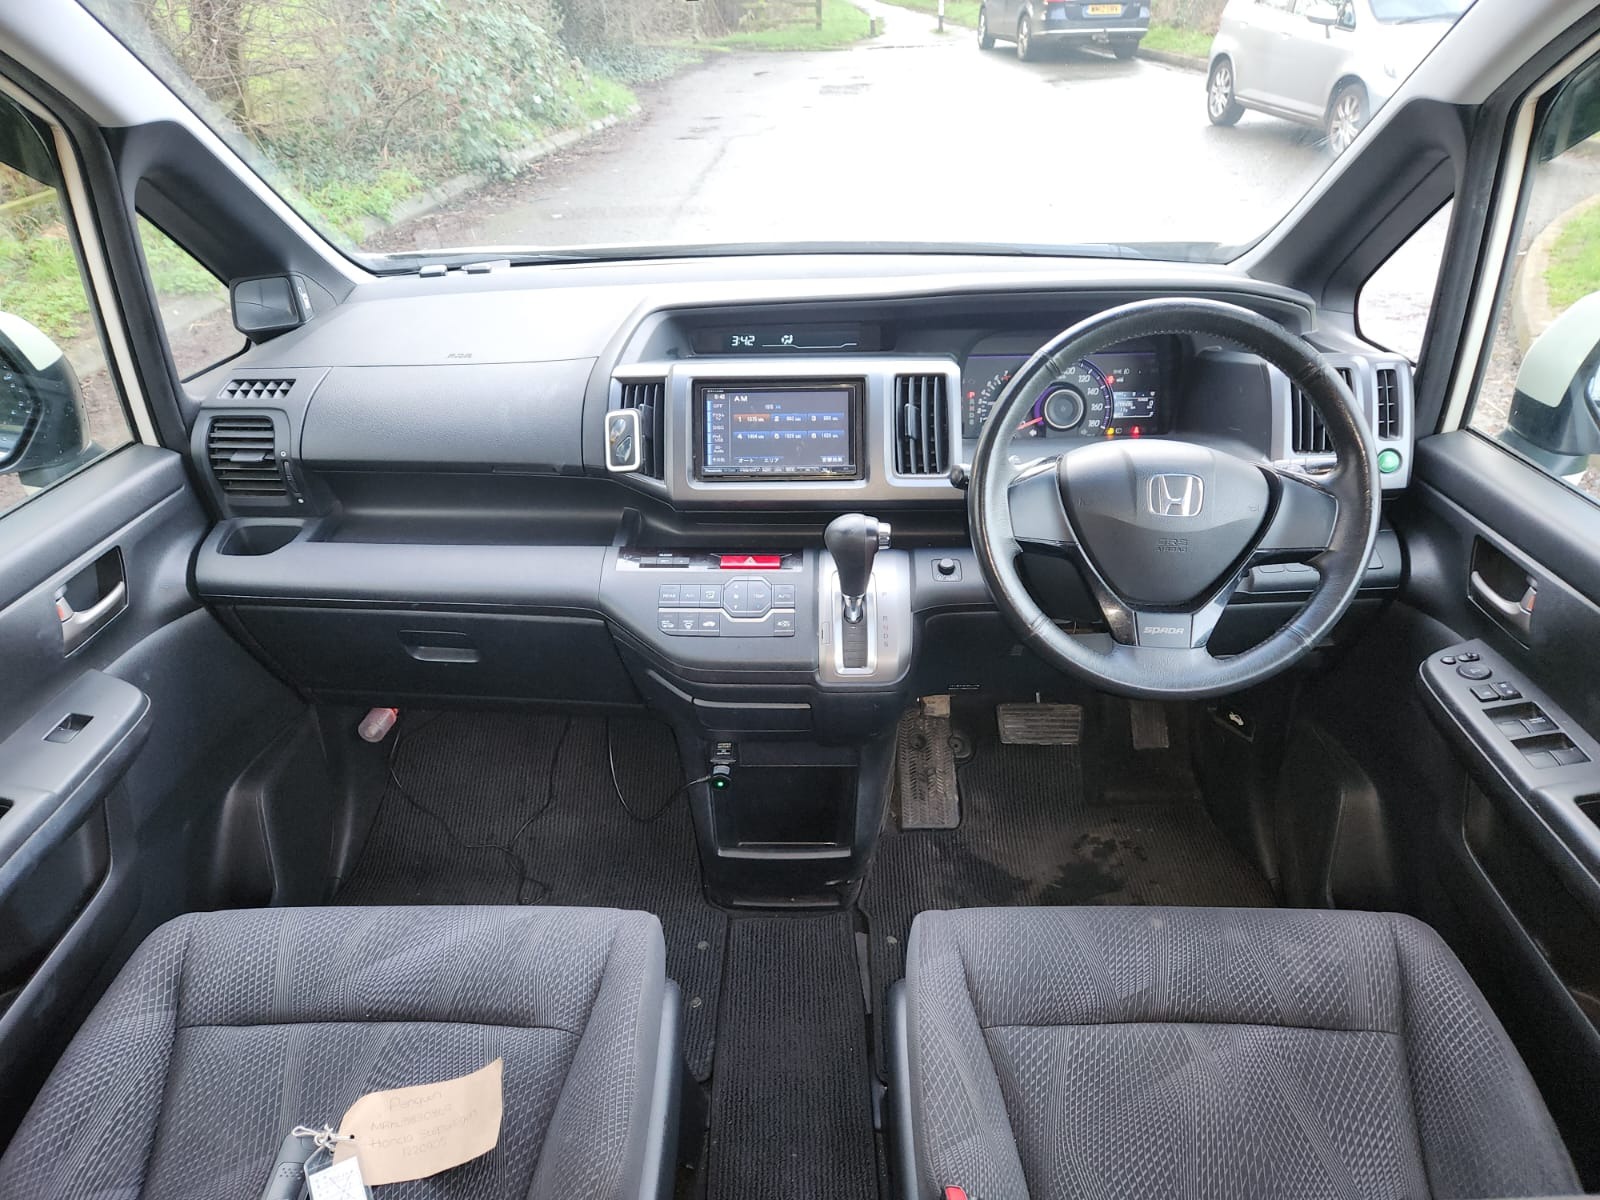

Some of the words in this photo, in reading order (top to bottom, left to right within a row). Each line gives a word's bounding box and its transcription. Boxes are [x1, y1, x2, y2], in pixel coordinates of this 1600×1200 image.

[1087, 387, 1099, 395] 140
[1091, 403, 1104, 411] 160
[1088, 419, 1101, 427] 180
